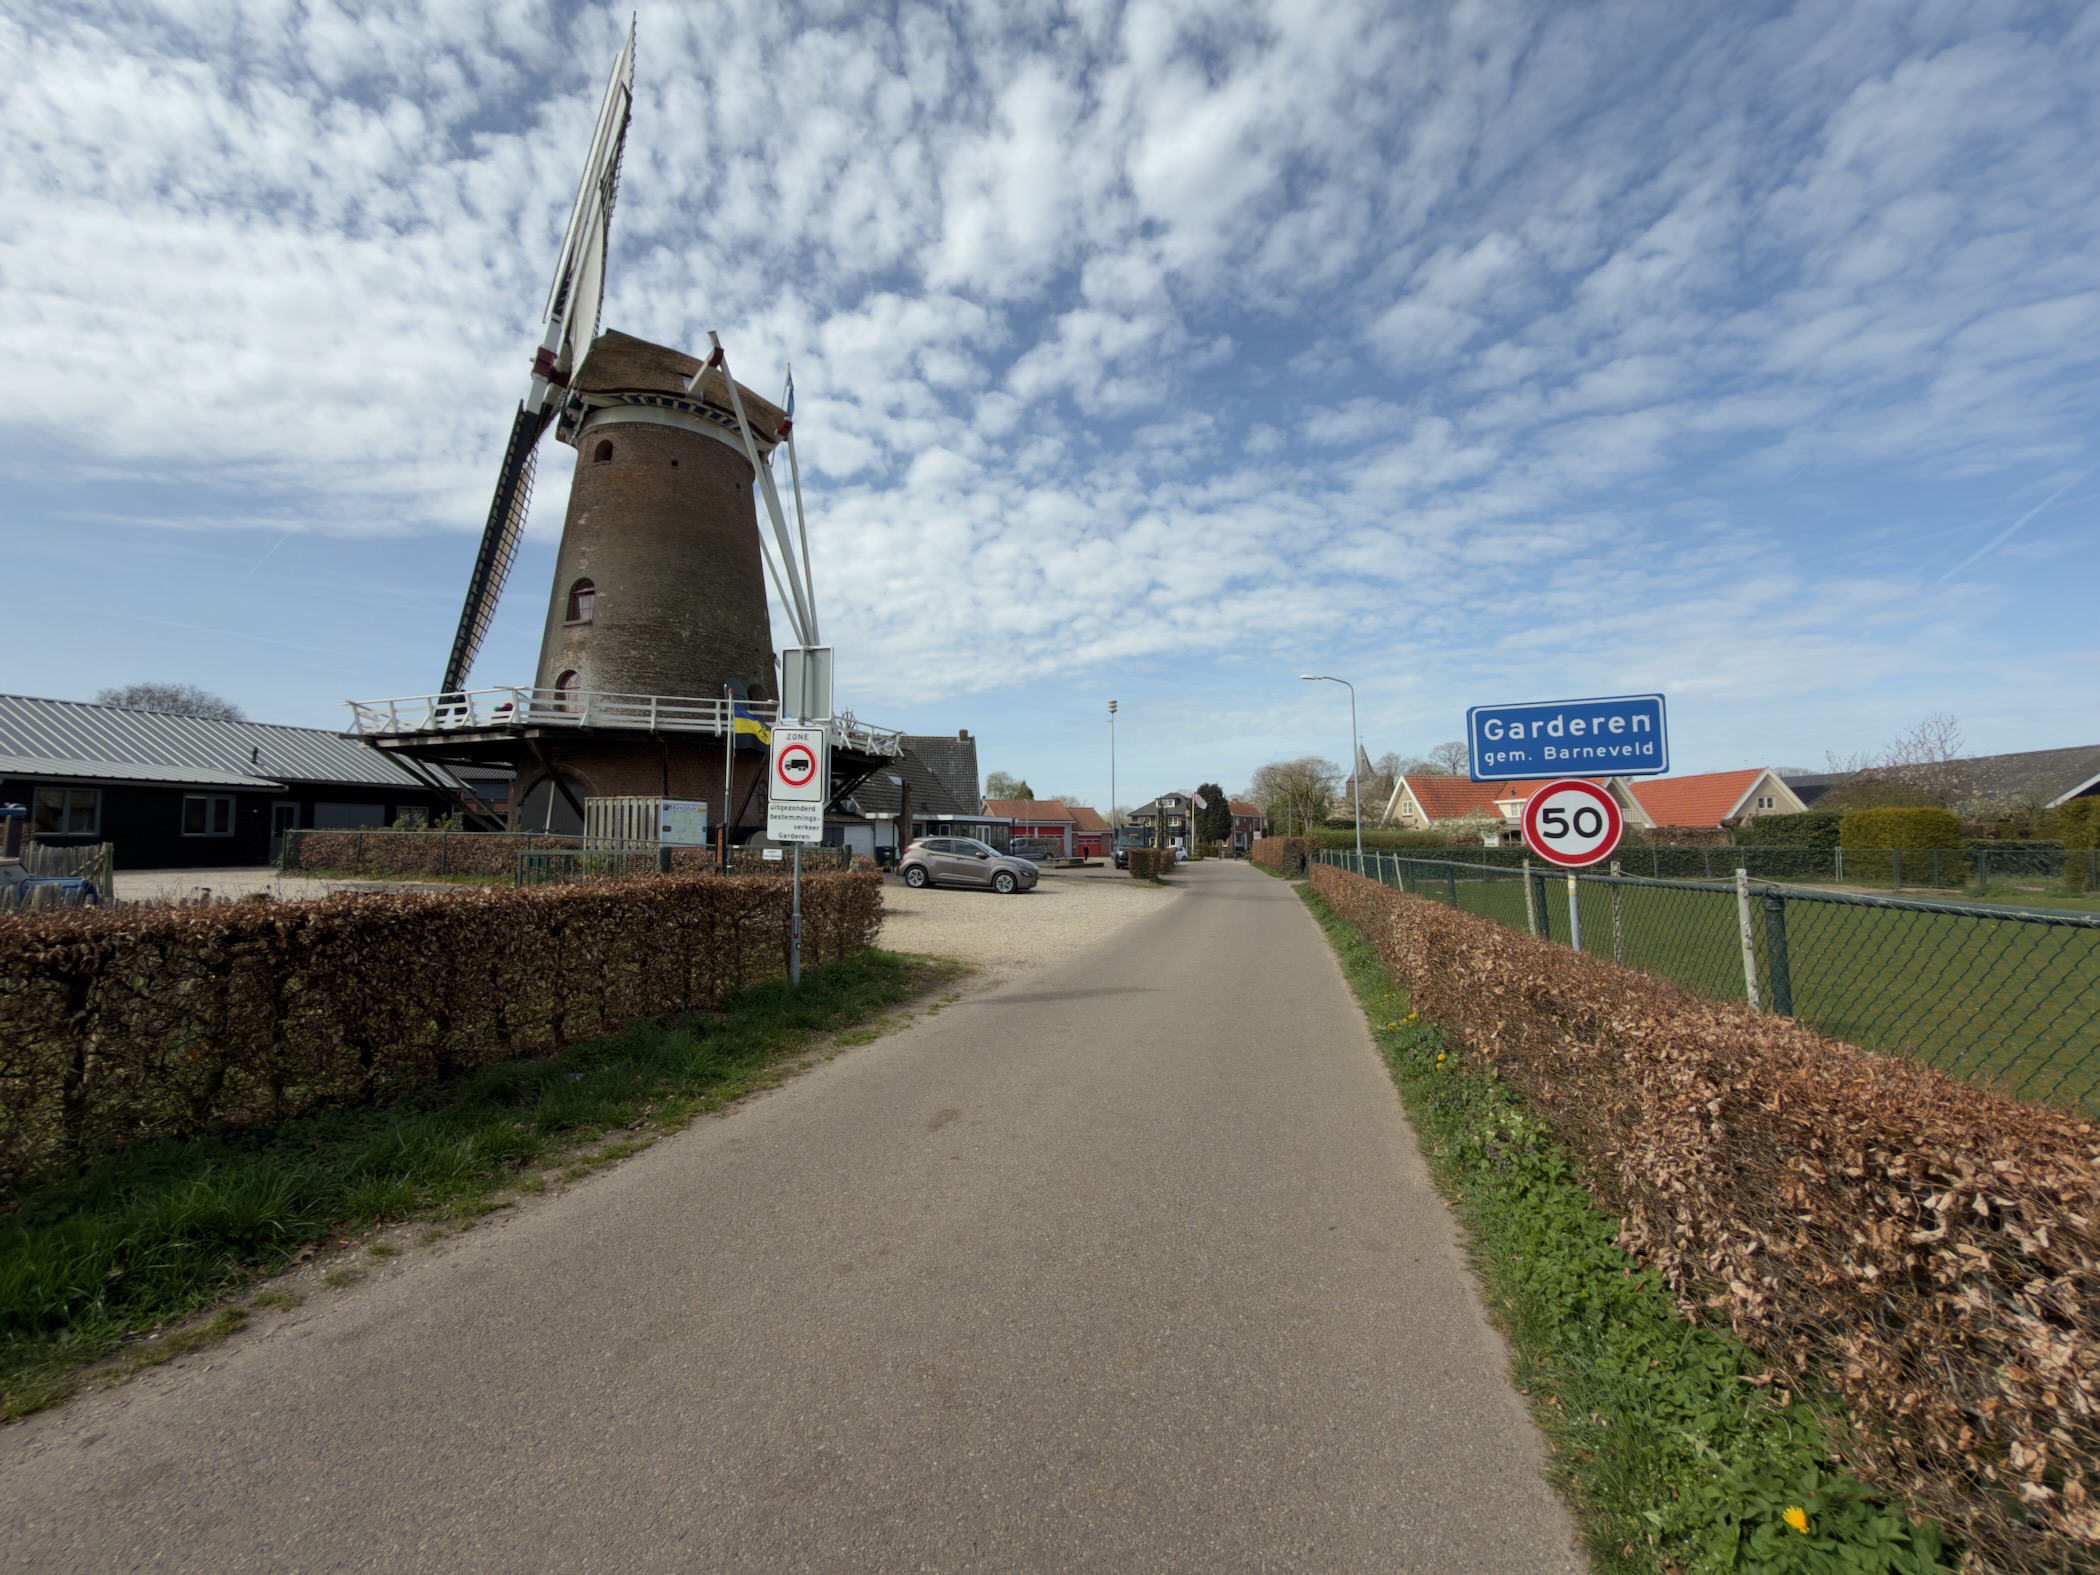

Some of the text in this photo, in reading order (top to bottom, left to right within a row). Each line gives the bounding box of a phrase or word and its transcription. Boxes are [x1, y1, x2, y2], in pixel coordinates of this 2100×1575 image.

[1484, 714, 1651, 741] Garderen
[786, 733, 809, 741] ZONE
[1484, 741, 1654, 767] gem. Barneveld
[770, 804, 816, 812] uitgezonderd
[770, 813, 820, 822] bestemmings-
[1542, 806, 1603, 839] 50
[778, 832, 811, 840] Garderen
